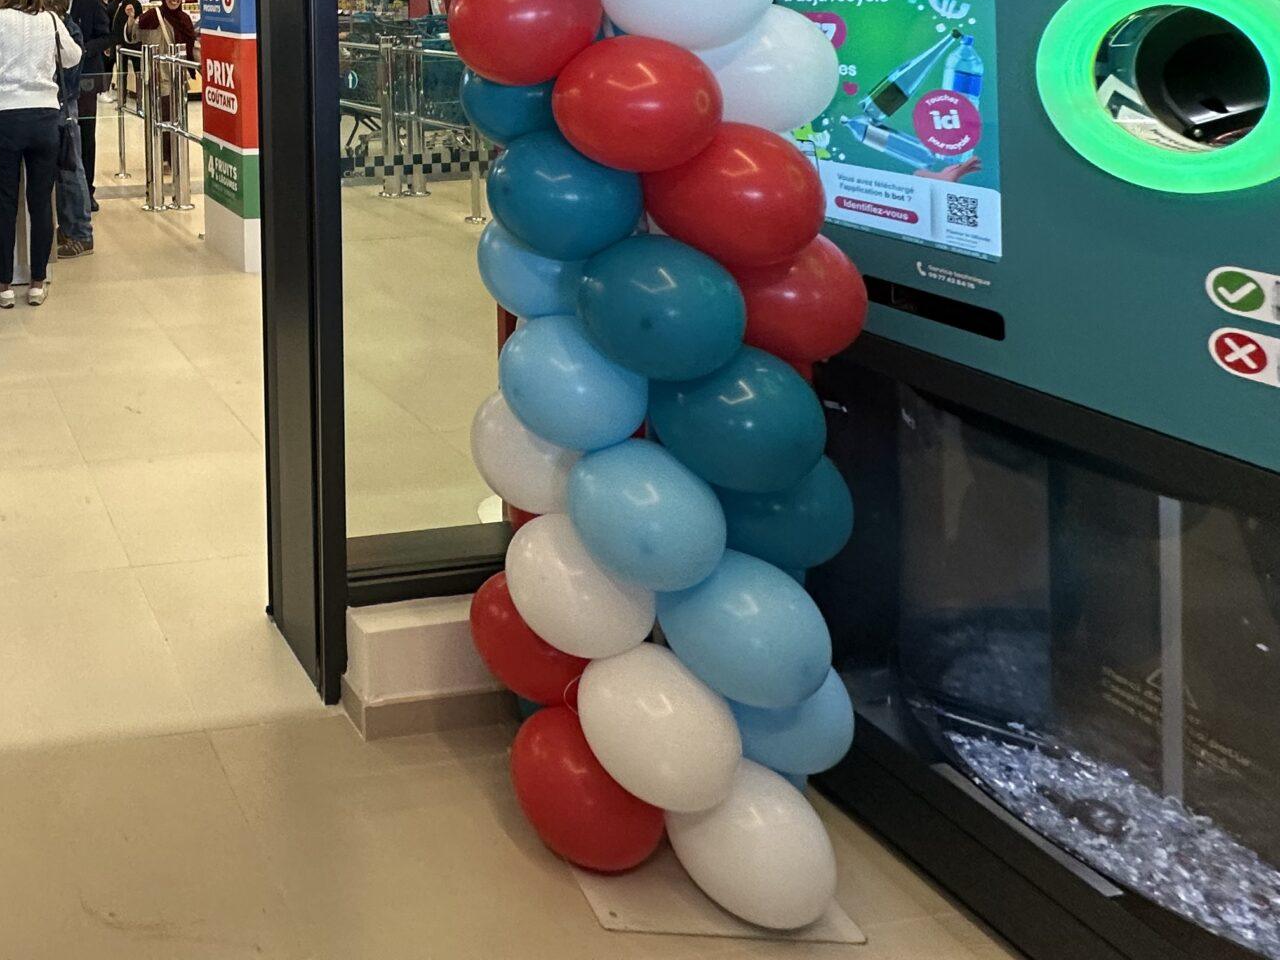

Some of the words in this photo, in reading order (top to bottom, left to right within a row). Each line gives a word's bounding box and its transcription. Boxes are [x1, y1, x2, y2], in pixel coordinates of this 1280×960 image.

[206, 58, 235, 89] PRIX
[207, 89, 236, 110] COÛTANT
[929, 109, 961, 130] ici
[207, 155, 215, 178] 4
[214, 157, 238, 181] FRUITS
[843, 199, 909, 220] Identifiez-vous
